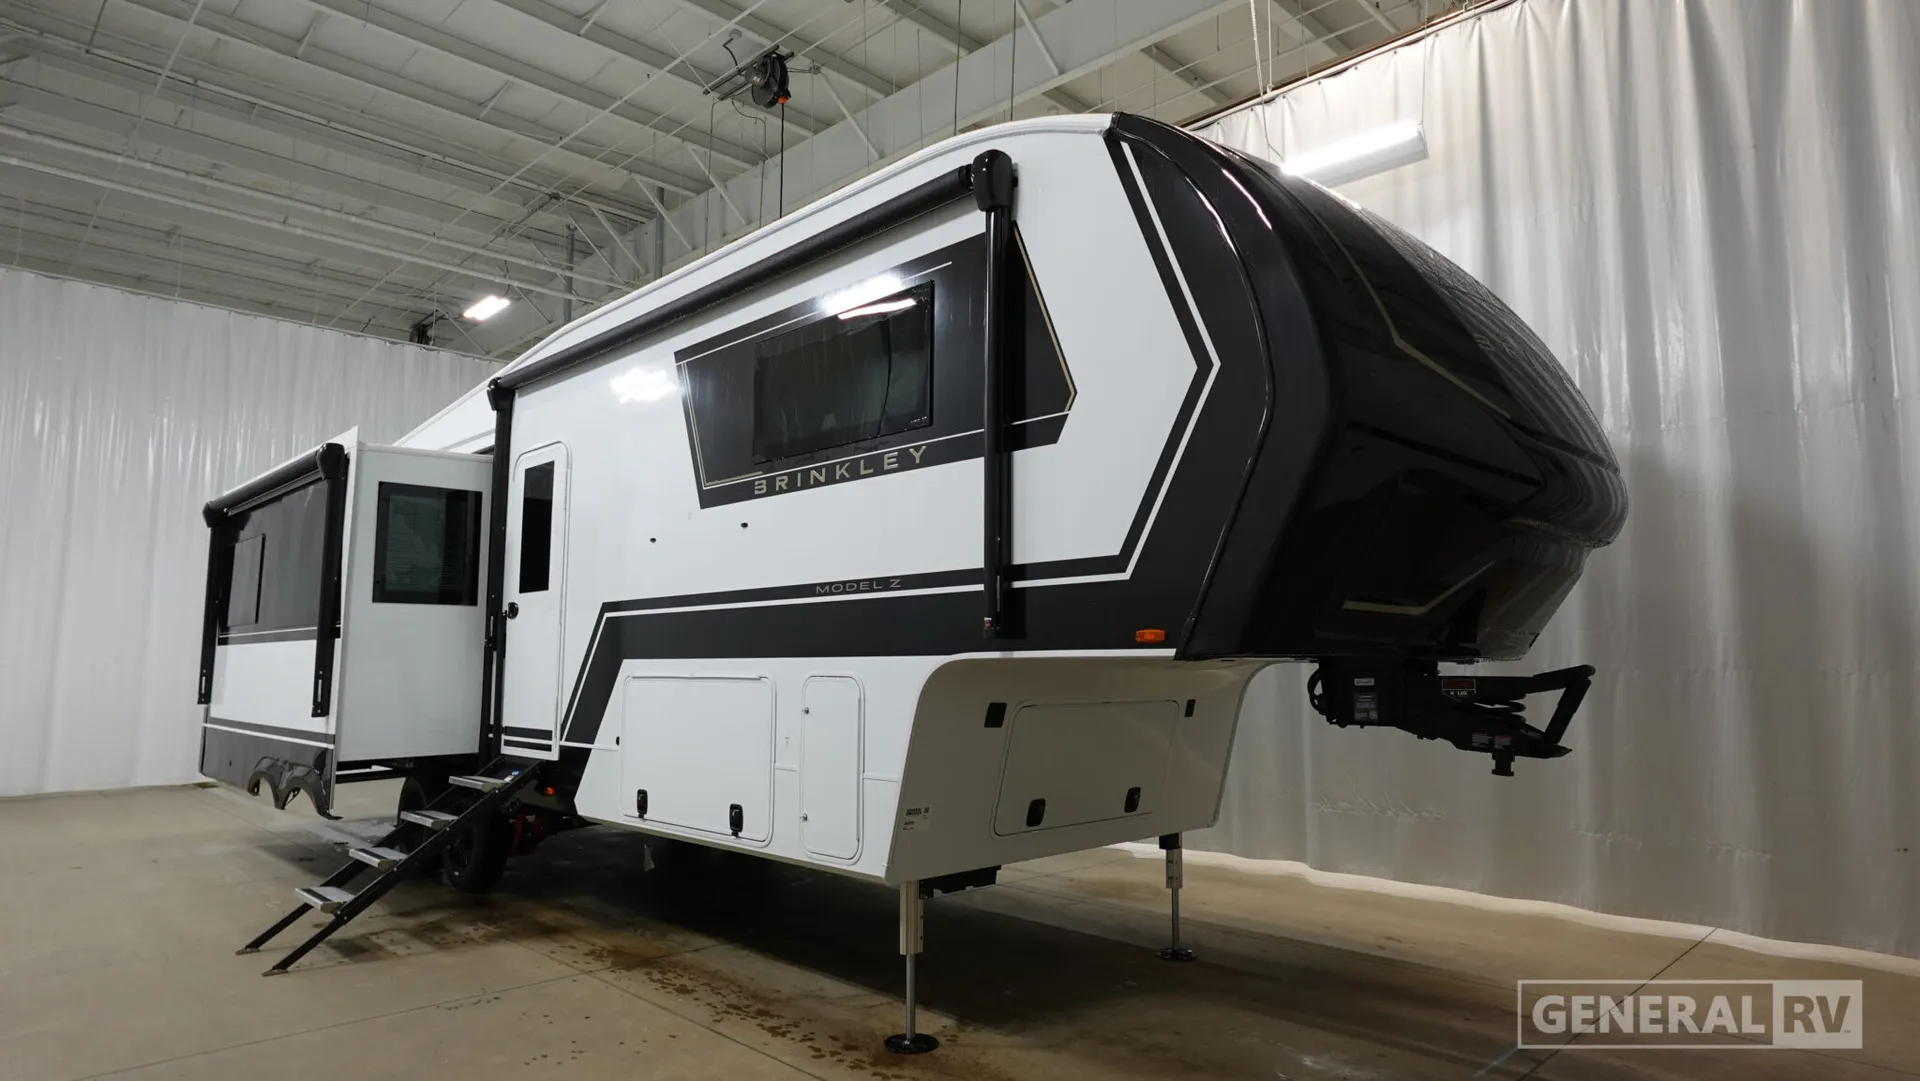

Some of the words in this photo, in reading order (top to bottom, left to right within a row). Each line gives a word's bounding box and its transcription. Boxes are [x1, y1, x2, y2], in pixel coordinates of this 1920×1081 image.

[754, 445, 927, 495] BRINKLEY
[815, 580, 883, 594] MODEL
[889, 578, 902, 588] Z
